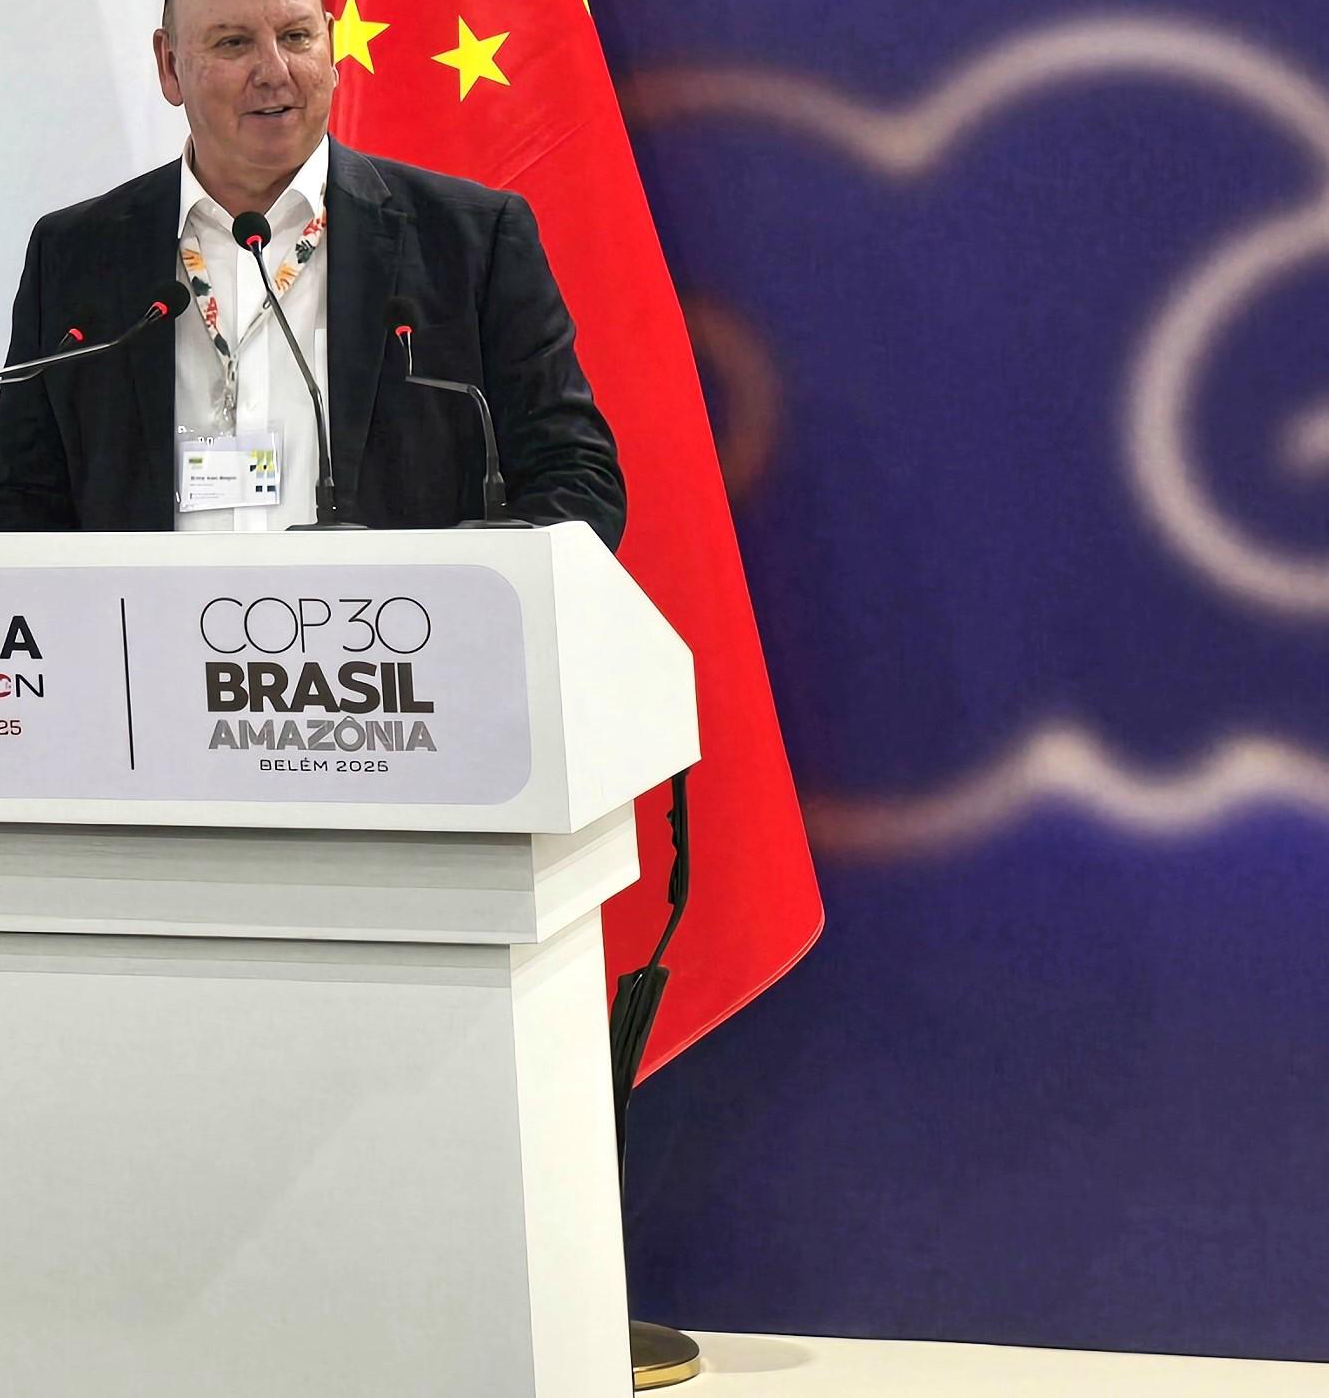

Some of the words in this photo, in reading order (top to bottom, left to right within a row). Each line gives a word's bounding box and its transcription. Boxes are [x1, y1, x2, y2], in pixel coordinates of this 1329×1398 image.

[205, 662, 434, 714] BRASIL
[208, 716, 437, 753] AMAZÔNIA
[259, 757, 328, 772] BELÉM
[335, 758, 389, 773] 2025
